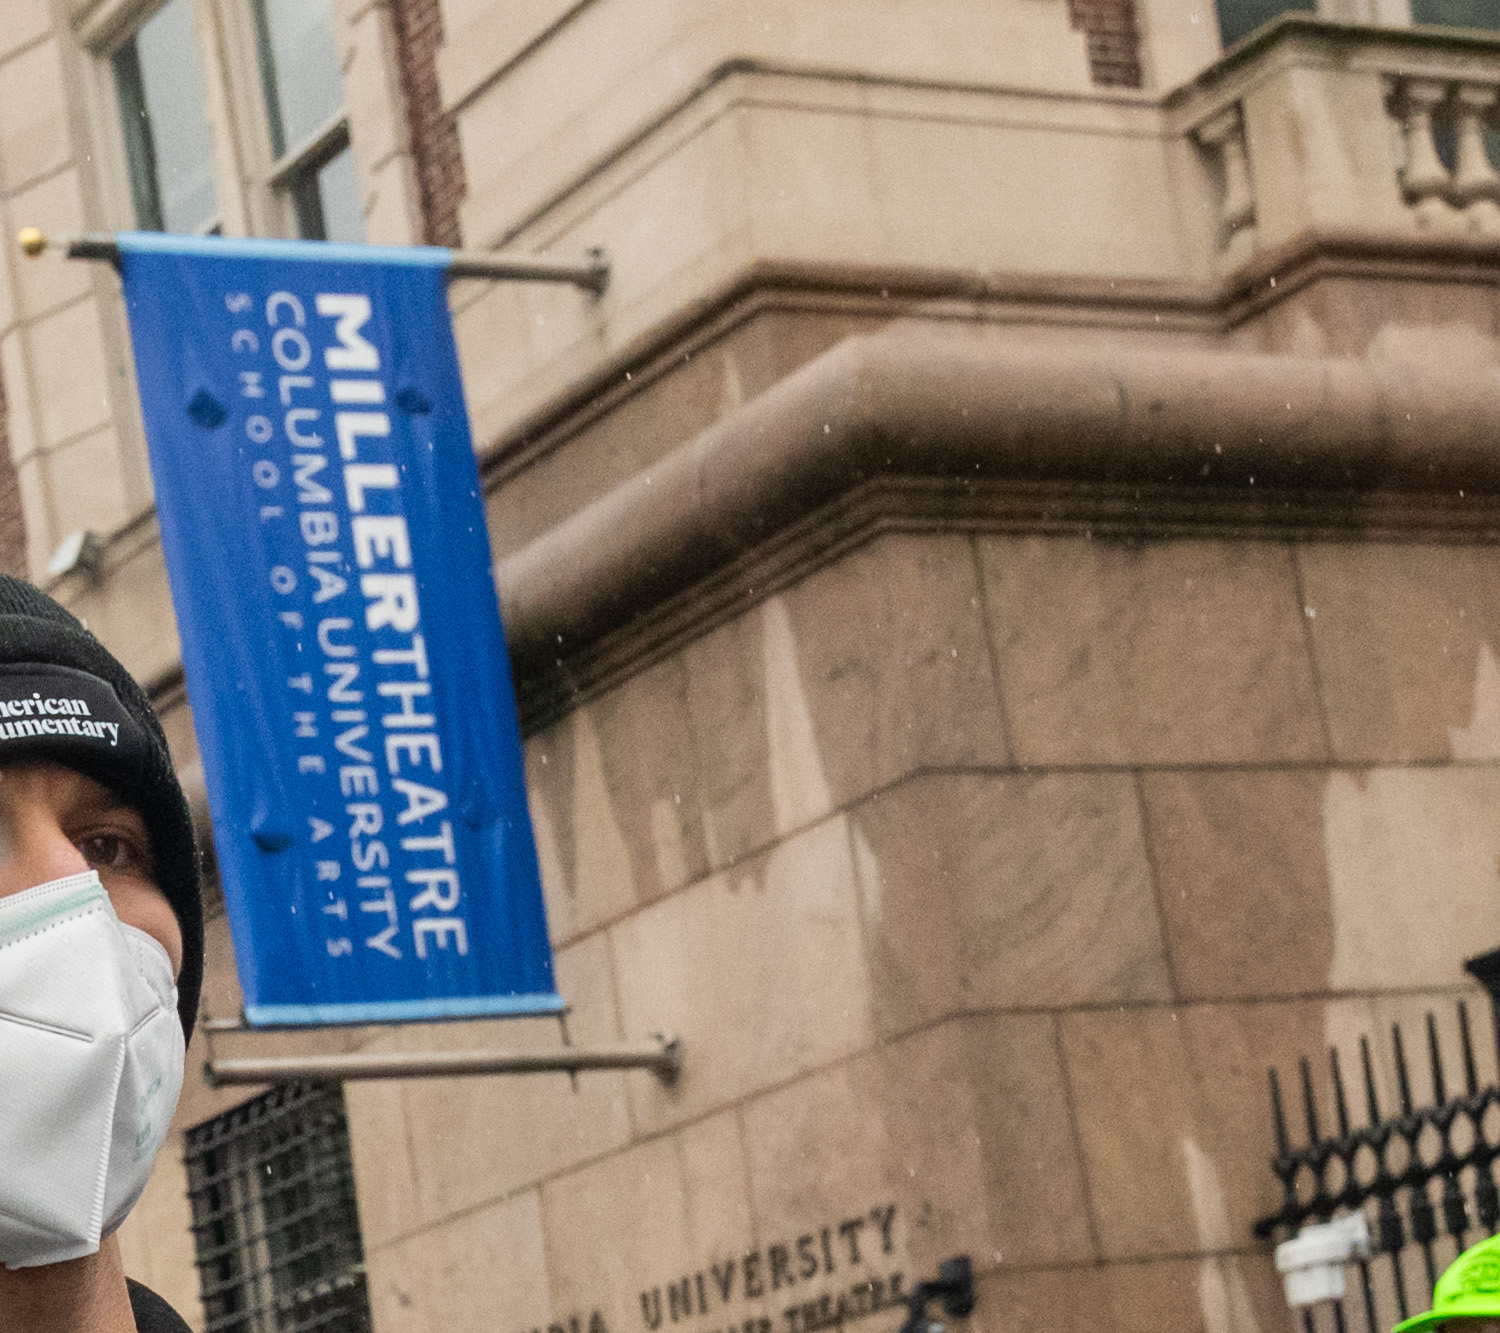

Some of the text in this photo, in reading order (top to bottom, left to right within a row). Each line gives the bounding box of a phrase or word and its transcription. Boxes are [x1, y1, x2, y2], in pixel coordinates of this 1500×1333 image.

[225, 293, 351, 958] SCHOOL OF THE ARTS
[266, 291, 401, 959] COLUMBIA UNIVERSITY
[640, 1204, 896, 1331] UNIVERSITY
